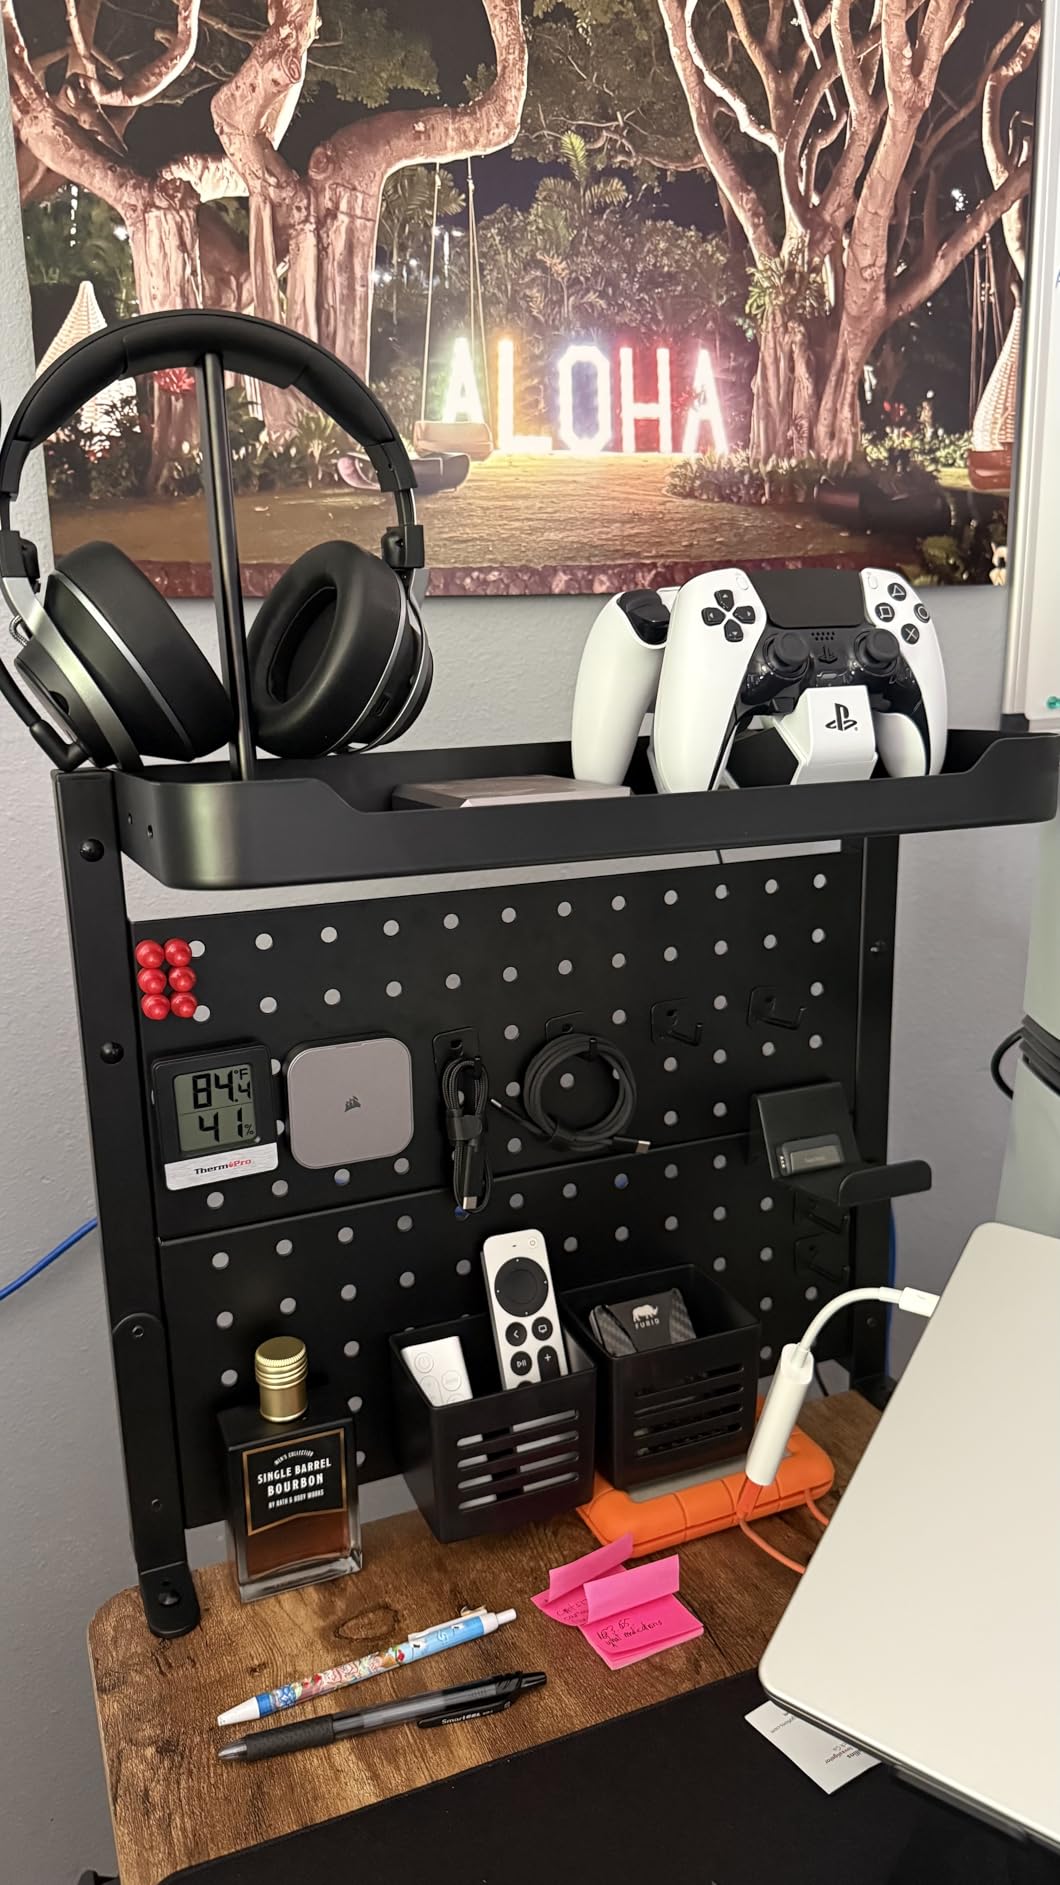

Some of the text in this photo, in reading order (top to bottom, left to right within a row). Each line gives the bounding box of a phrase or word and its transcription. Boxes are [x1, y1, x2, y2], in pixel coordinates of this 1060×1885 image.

[442, 337, 729, 453] ALOHA
[193, 1158, 252, 1175] ThermoPro
[257, 1457, 332, 1484] SINGLE BARREL
[274, 1454, 288, 1466] MEN'S
[267, 1472, 324, 1497] BOURBON
[268, 1501, 275, 1509] BY
[276, 1497, 288, 1507] BATH
[293, 1493, 306, 1503] BODY
[307, 1488, 324, 1499] WORKS
